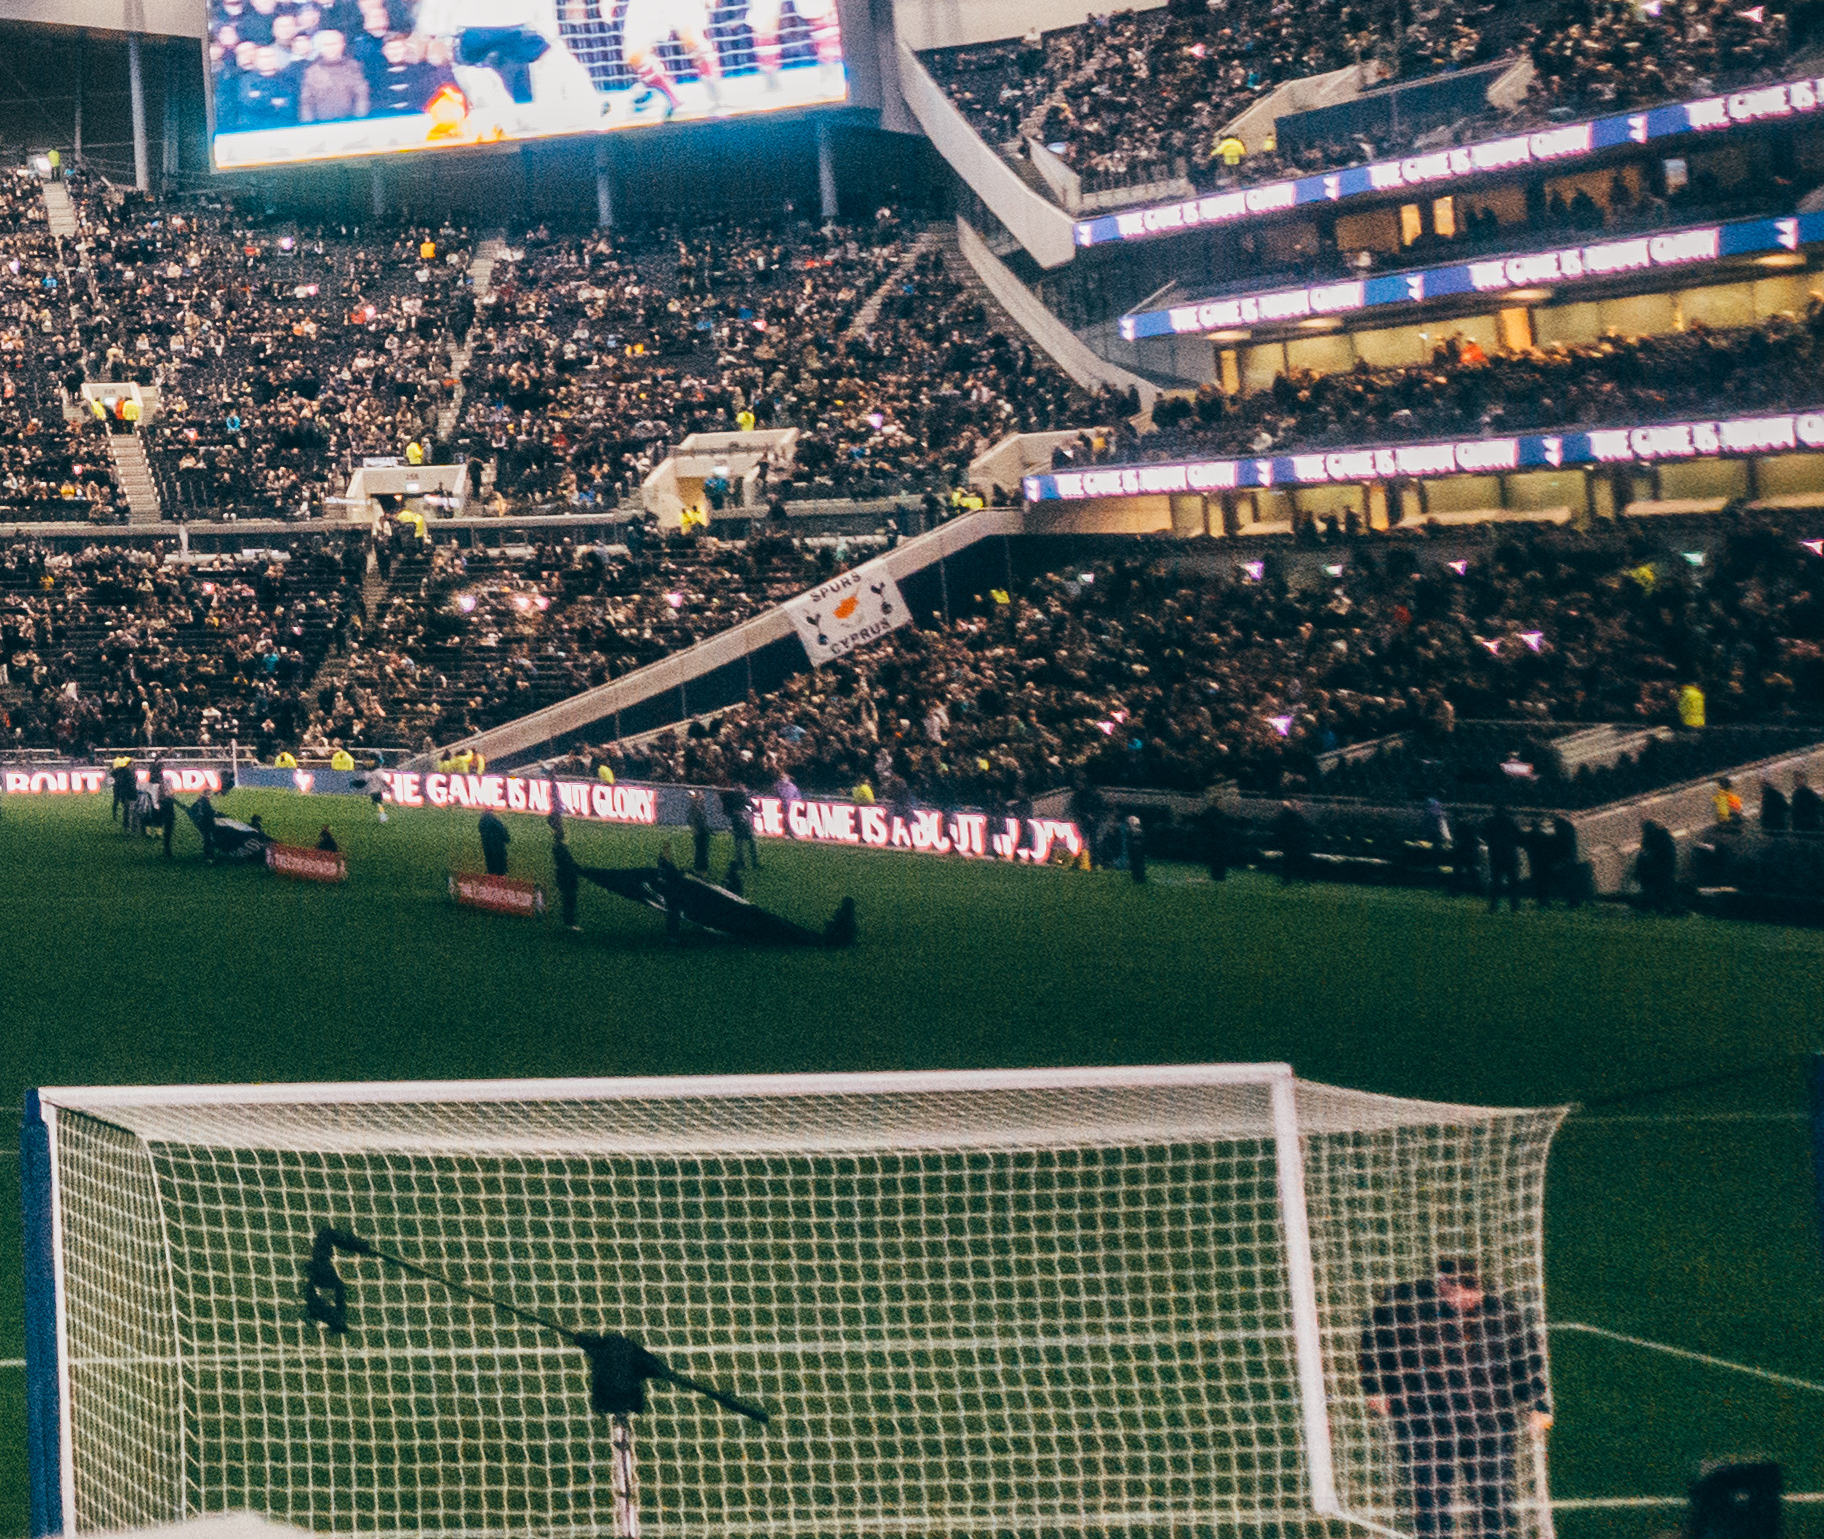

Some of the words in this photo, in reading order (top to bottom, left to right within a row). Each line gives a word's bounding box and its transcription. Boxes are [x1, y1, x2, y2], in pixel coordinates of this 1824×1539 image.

[809, 571, 861, 603] SPURS
[831, 618, 891, 655] CYPRUS
[426, 773, 506, 808] GAME
[789, 801, 860, 843] GAME
[859, 806, 888, 845] IS
